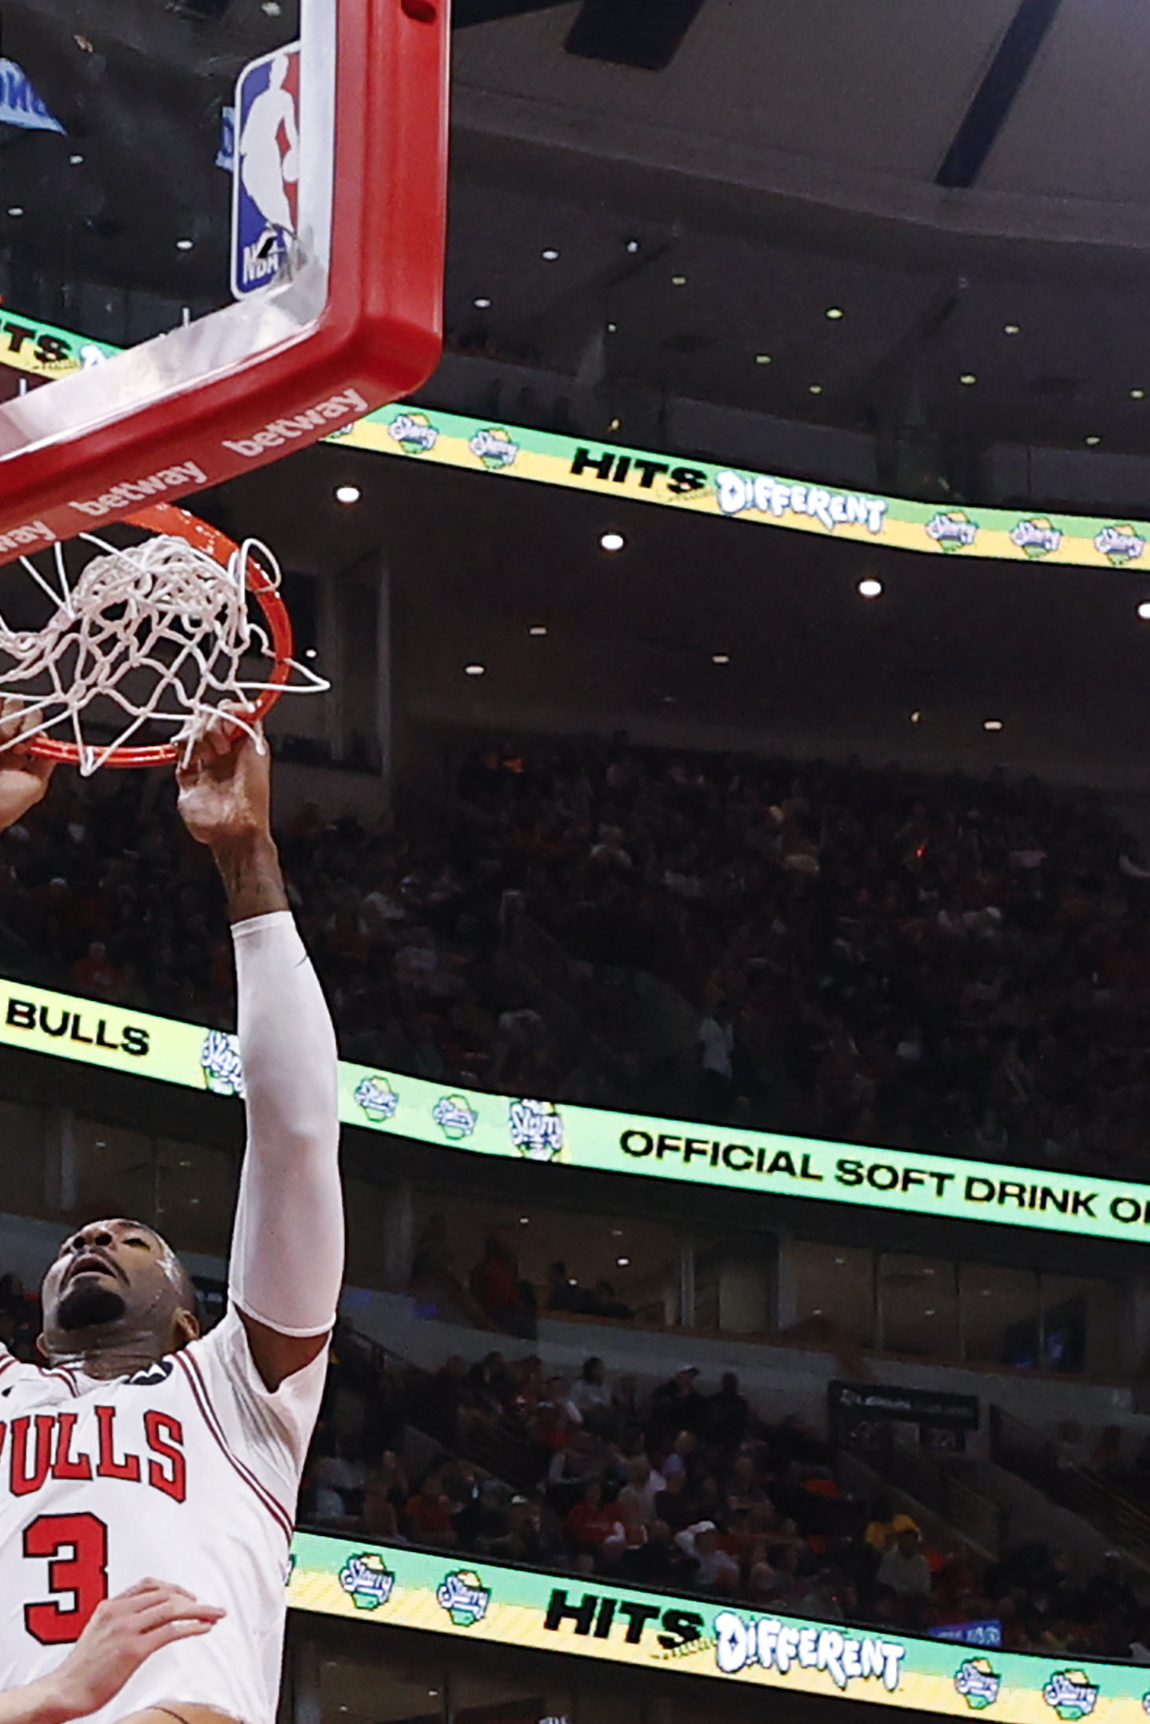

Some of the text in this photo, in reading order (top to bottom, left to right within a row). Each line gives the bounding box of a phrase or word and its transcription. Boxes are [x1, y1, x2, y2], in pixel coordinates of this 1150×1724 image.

[222, 388, 368, 456] betway
[67, 461, 208, 516] betway
[569, 447, 708, 495] HITS
[6, 997, 150, 1056] BULLS
[619, 1129, 825, 1181] OFFICIAL
[835, 1158, 955, 1199] SOFT
[964, 1176, 1099, 1218] DRINK
[22, 1511, 109, 1647] 3
[544, 1589, 906, 1692] HITS DIFFERENT
